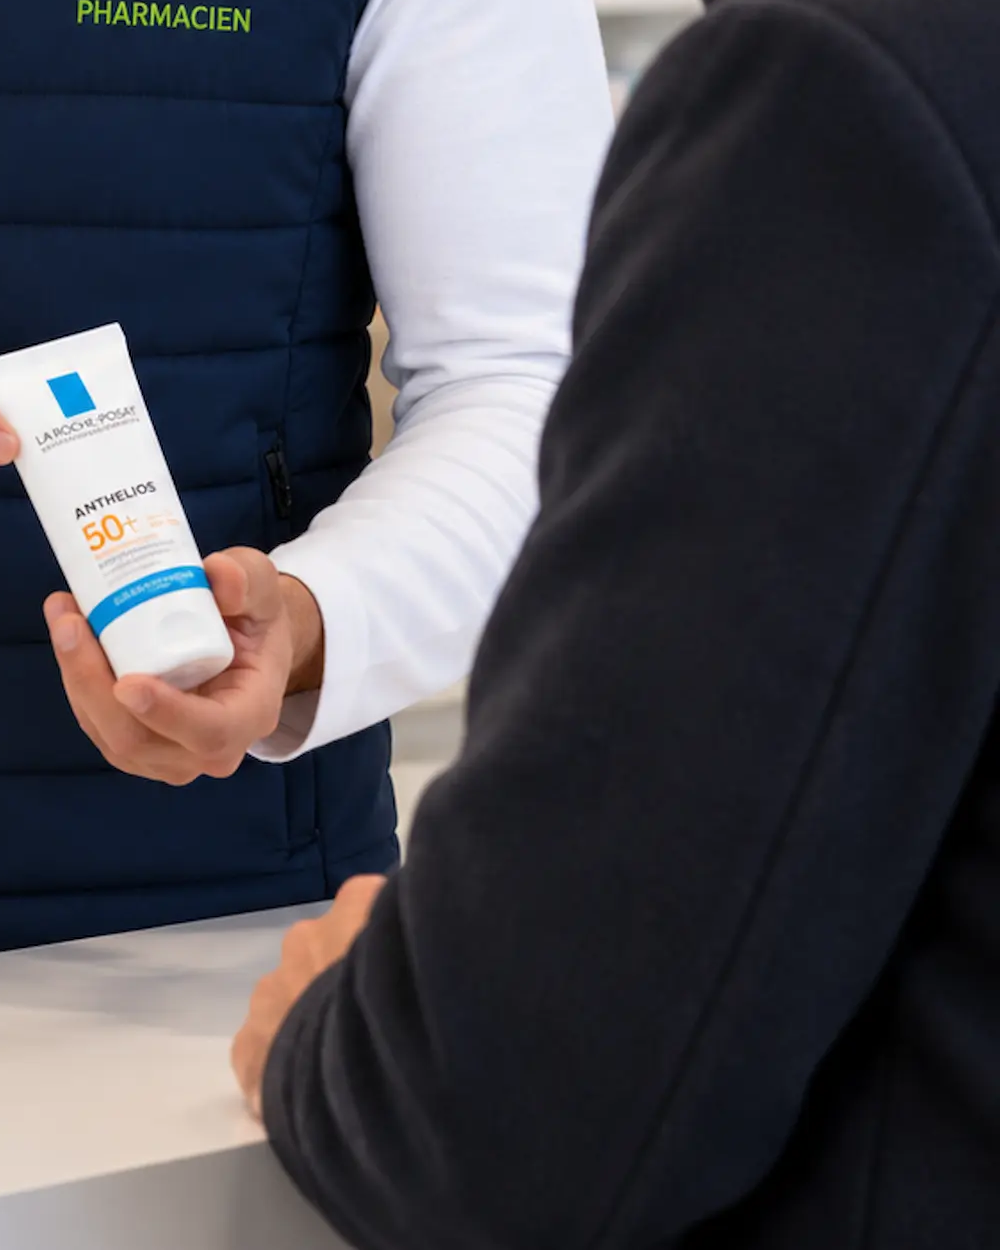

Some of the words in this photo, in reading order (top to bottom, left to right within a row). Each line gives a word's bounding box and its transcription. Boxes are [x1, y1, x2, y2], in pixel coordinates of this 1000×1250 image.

[76, 0, 252, 33] PHARMACIEN
[74, 481, 157, 520] ANTHELIOS
[82, 514, 138, 552] 50+
